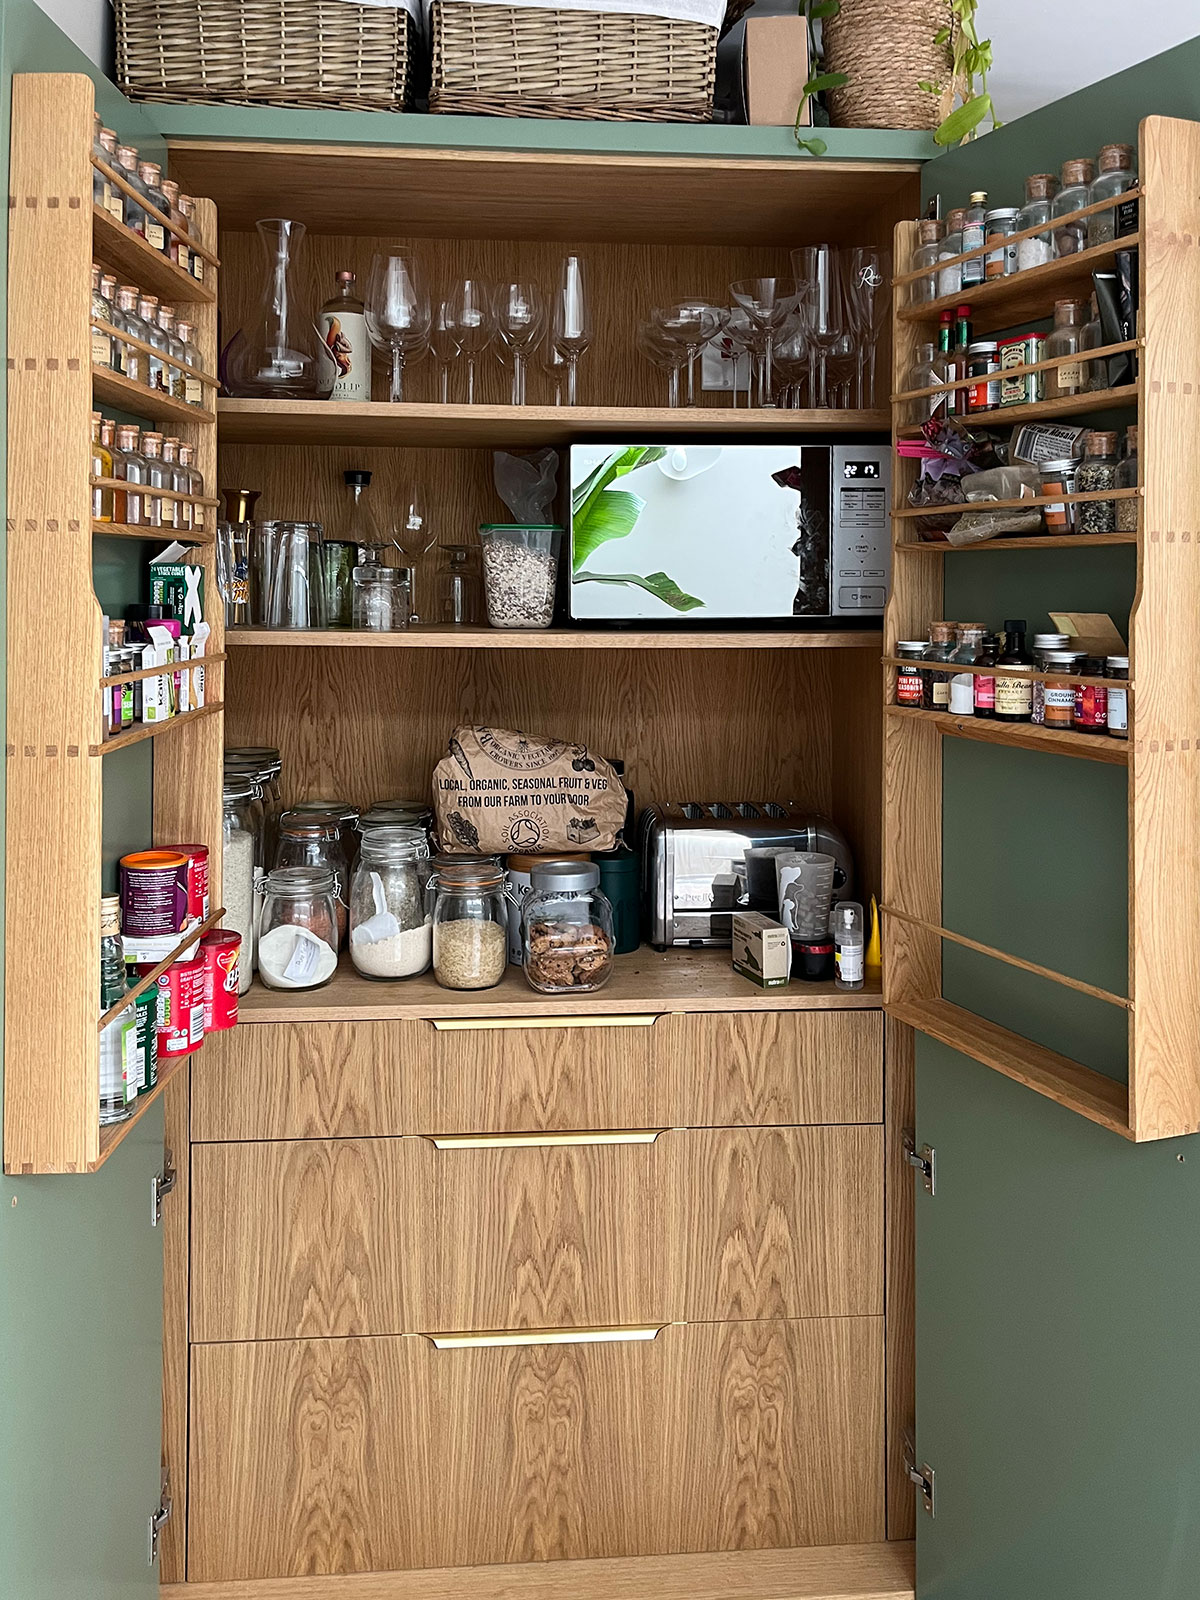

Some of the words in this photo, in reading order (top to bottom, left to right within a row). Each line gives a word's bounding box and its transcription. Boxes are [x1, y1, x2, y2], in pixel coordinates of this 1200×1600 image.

[1026, 423, 1050, 435] Garam
[1048, 427, 1077, 441] Masala
[489, 750, 524, 769] GROWERS
[525, 757, 547, 769] SINCE
[439, 778, 468, 793] LOCAL,
[469, 778, 510, 791] ORGANIC,
[512, 778, 557, 790] SEASONAL
[558, 777, 583, 790] FRUIT
[584, 778, 590, 790] &
[591, 778, 608, 790] VEG
[457, 796, 482, 808] FROM
[483, 795, 502, 807] OUR
[503, 795, 528, 807] FARM
[529, 794, 541, 806] TO
[542, 793, 567, 805] YOUR
[567, 794, 590, 806] DOOR
[501, 824, 511, 844] SOIL
[508, 809, 550, 842] ASSOCIATION
[507, 843, 545, 854] ORGANIC
